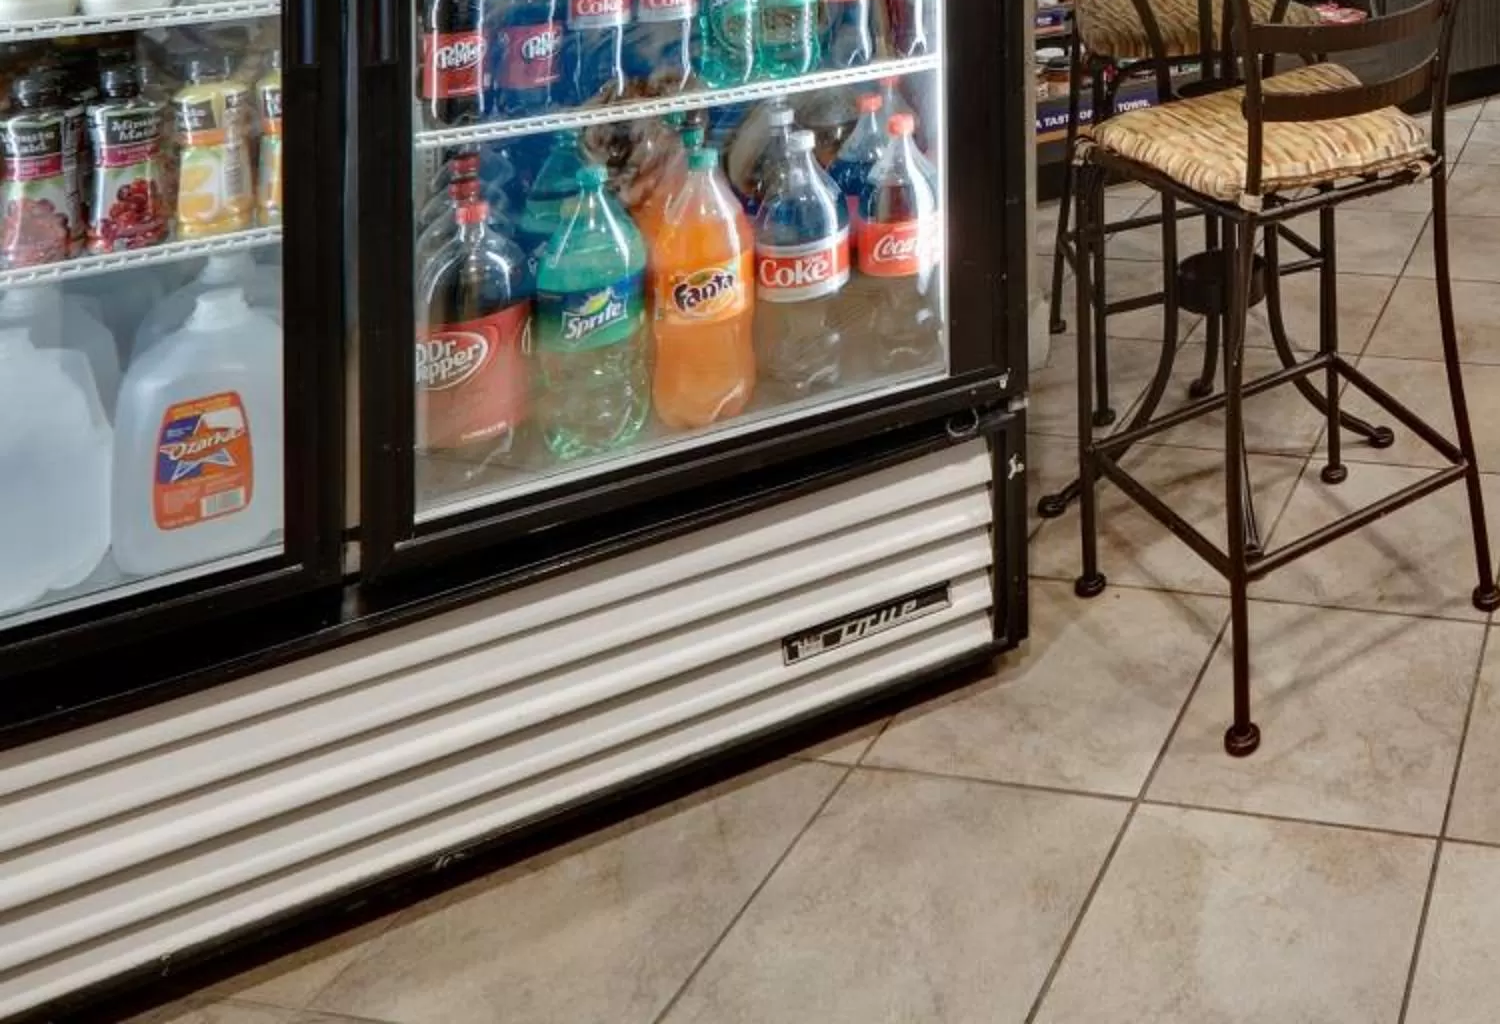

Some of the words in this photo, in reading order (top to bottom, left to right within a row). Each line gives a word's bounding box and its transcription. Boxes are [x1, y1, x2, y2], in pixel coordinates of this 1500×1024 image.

[1044, 114, 1069, 128] TAST
[760, 258, 829, 288] Coke
[674, 273, 734, 311] Fanta
[564, 298, 623, 340] Sprite
